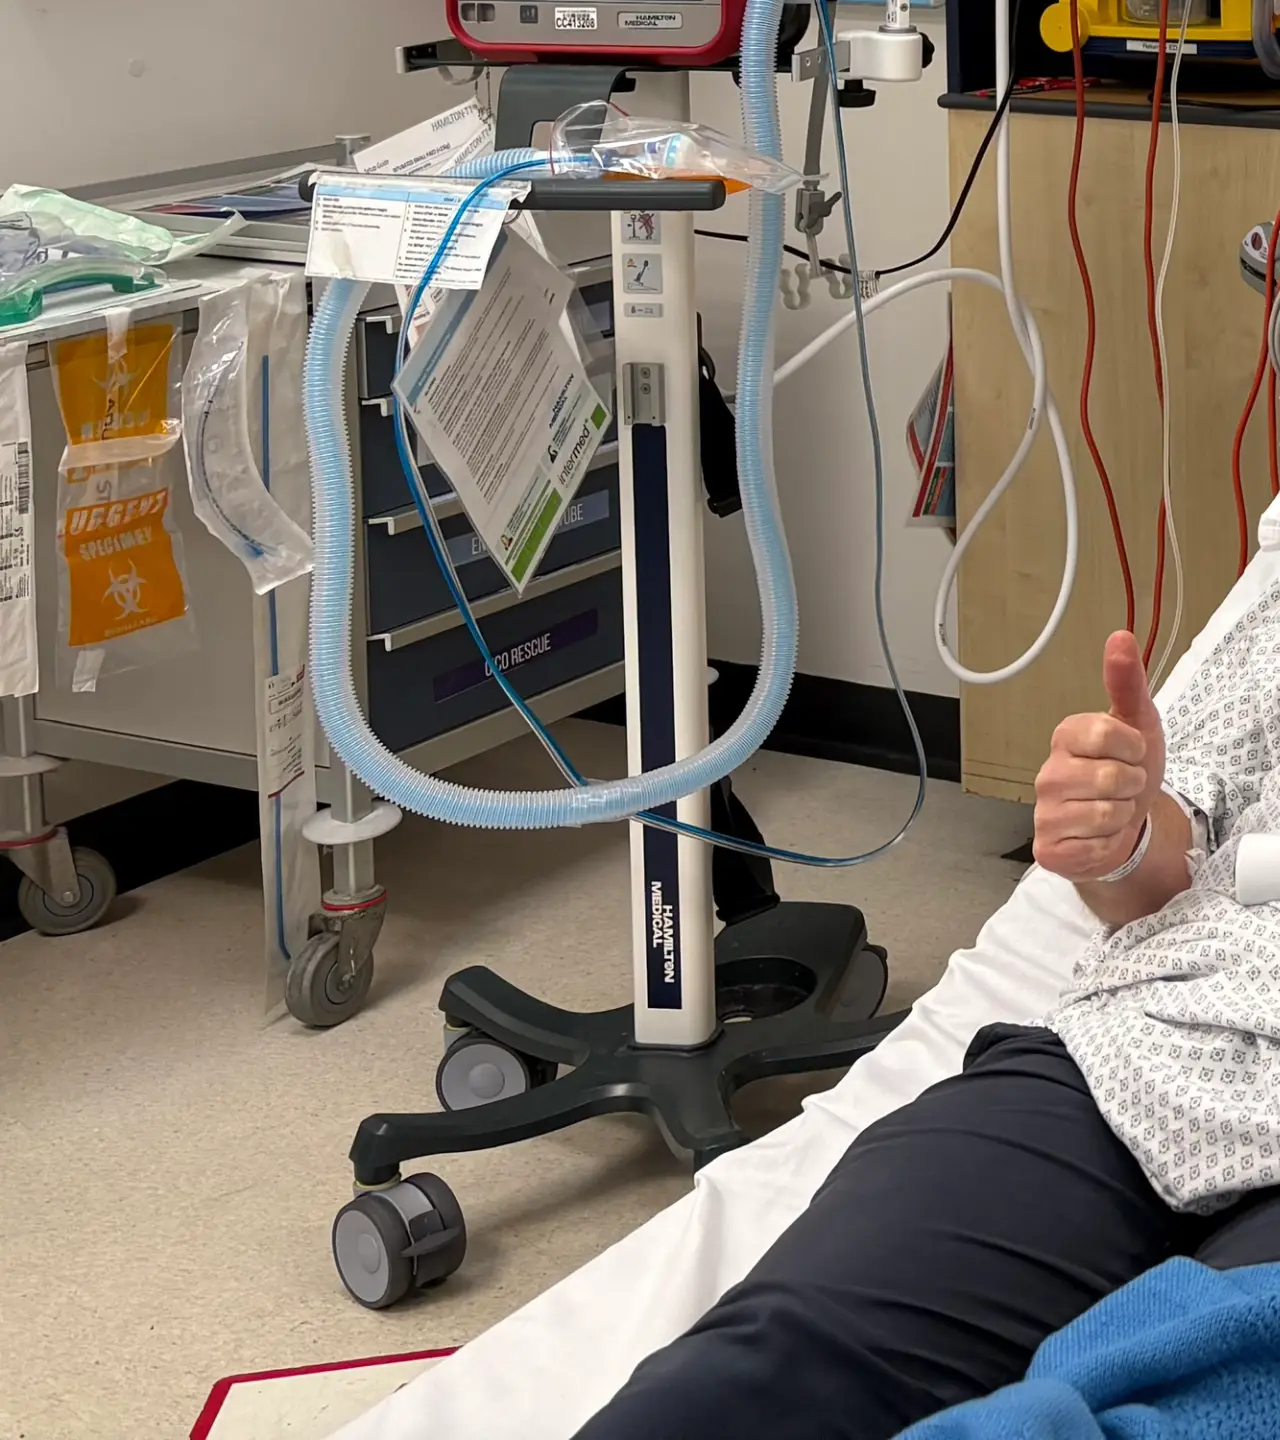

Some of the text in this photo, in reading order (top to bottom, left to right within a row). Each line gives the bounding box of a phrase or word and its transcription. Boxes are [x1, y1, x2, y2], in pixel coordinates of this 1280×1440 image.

[558, 424, 590, 485] intermed
[484, 633, 552, 678] CCO RESCUE
[651, 880, 664, 949] MEDICAL
[662, 904, 675, 984] HAMILTON
